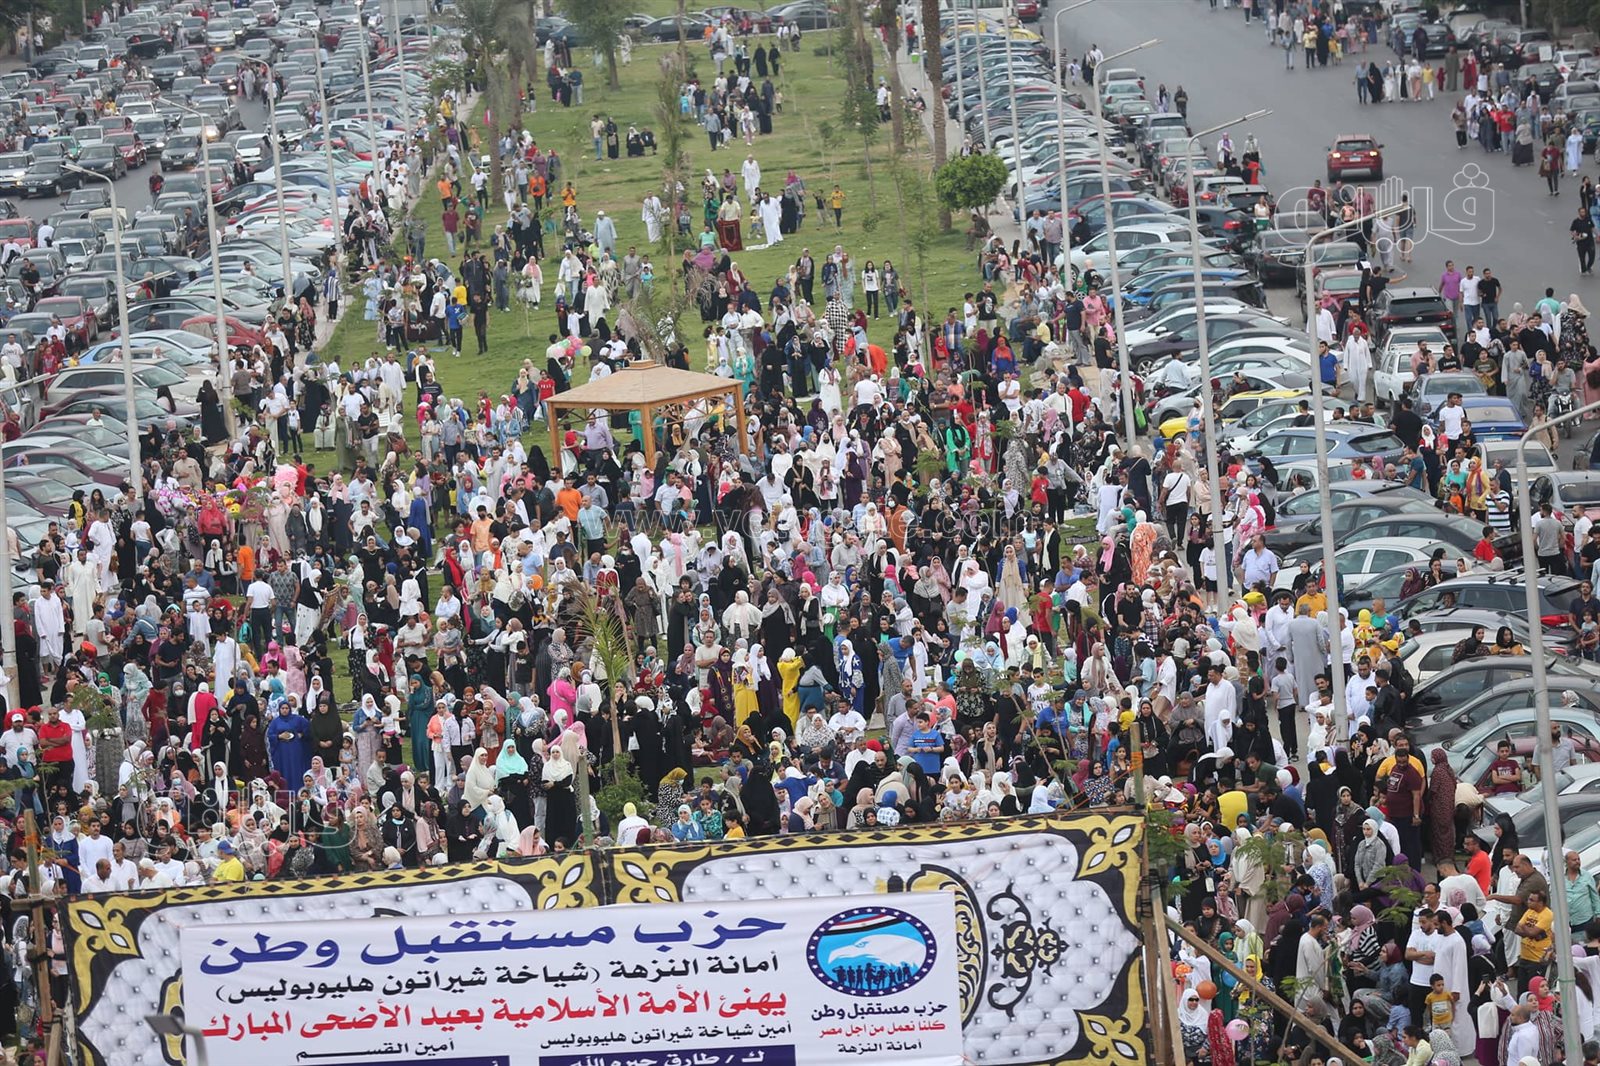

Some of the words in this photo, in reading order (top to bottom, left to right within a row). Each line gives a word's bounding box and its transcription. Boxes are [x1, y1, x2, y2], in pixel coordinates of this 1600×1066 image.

[634, 911, 786, 952] حزب
[361, 919, 615, 965] مستقبل
[200, 932, 340, 974] وطن
[707, 951, 778, 974] أمانة
[496, 962, 600, 987] (شياخة
[609, 957, 698, 982] النزهة
[216, 976, 373, 1004] هليوبوليس)
[383, 967, 487, 996] شيراتون
[638, 984, 709, 1014] الأمة
[719, 987, 786, 1018] يهنئ
[300, 999, 410, 1038] الأضحى
[421, 1006, 484, 1031] بعيد
[811, 1004, 846, 1021] وطن
[848, 1002, 909, 1020] مستقبل
[914, 1002, 948, 1018] حزب
[201, 1010, 292, 1041] المبارك
[631, 1026, 693, 1044] شيراتون
[698, 1024, 753, 1039] شياخة
[758, 1020, 791, 1039] أمين
[819, 1028, 842, 1039] مصر
[869, 1024, 884, 1036] من
[888, 1021, 915, 1035] نعمل
[919, 1020, 945, 1032] كلنا
[415, 1038, 454, 1056] أمين
[540, 1032, 626, 1050] هليوبوليس
[838, 1042, 881, 1055] النزهة
[887, 1038, 922, 1051] أمانة
